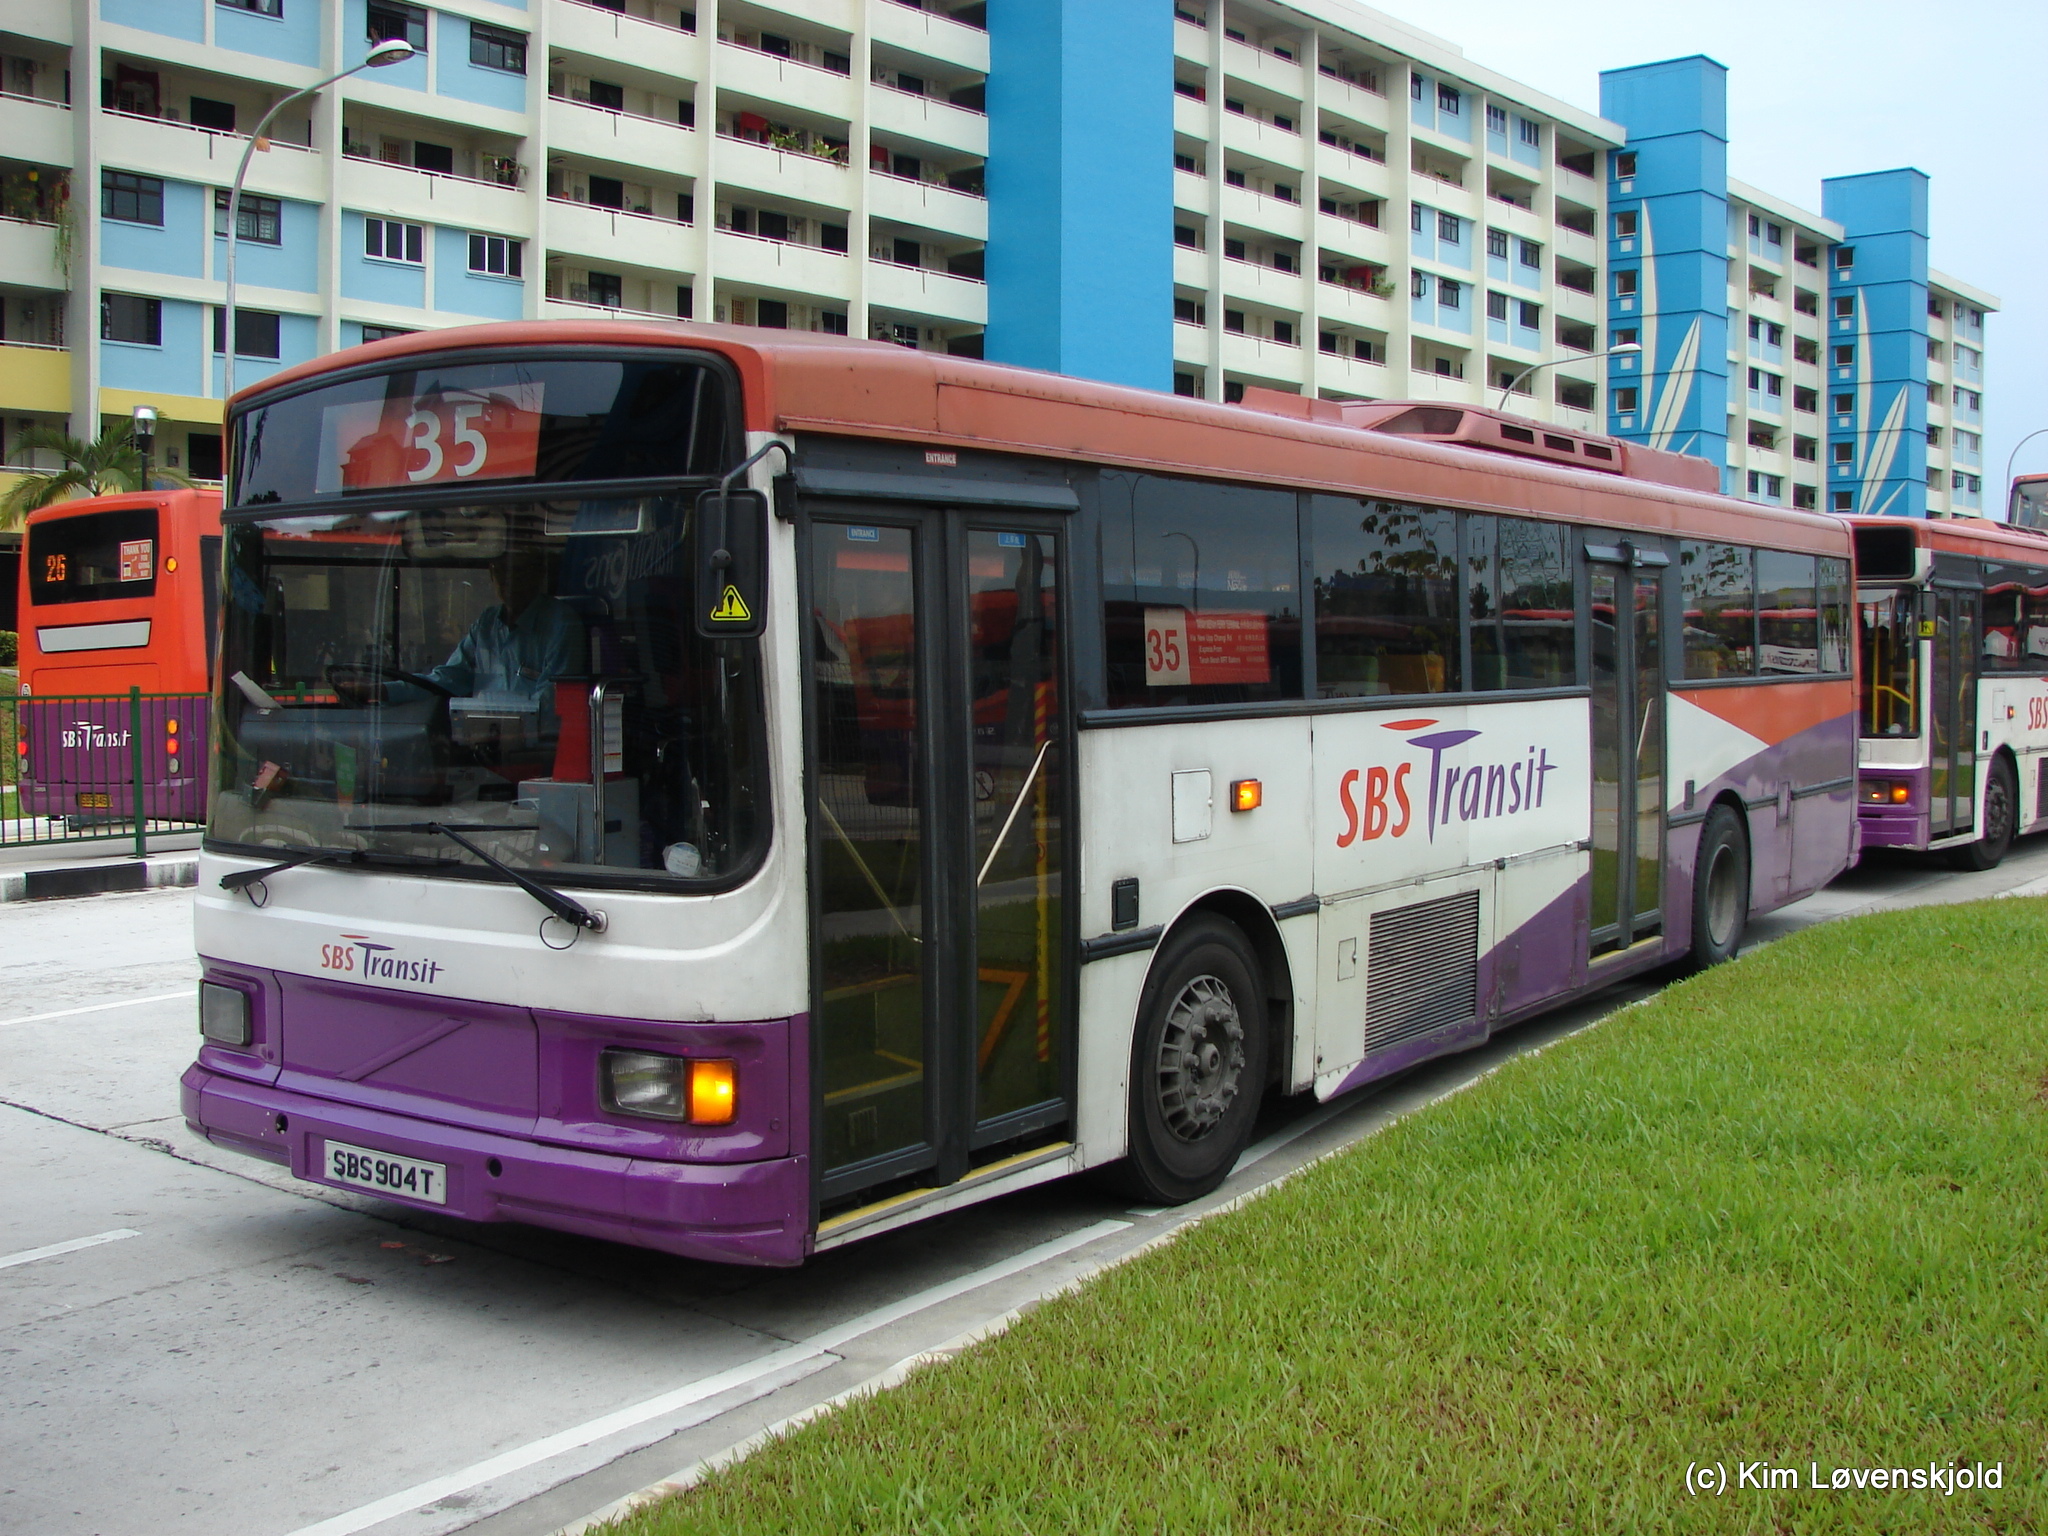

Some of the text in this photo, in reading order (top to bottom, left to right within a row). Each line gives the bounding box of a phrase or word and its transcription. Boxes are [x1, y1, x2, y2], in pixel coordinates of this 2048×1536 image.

[408, 403, 488, 482] 35
[925, 452, 957, 465] ENTRANCE
[851, 528, 876, 539] ENTRANCE
[46, 554, 66, 582] 26
[1147, 628, 1181, 672] 35
[2028, 696, 2048, 731] SBS
[62, 730, 82, 748] SBS
[1336, 729, 1559, 848] SBS Transit
[321, 942, 446, 984] SBS Transit
[333, 1149, 435, 1195] SBS904T
